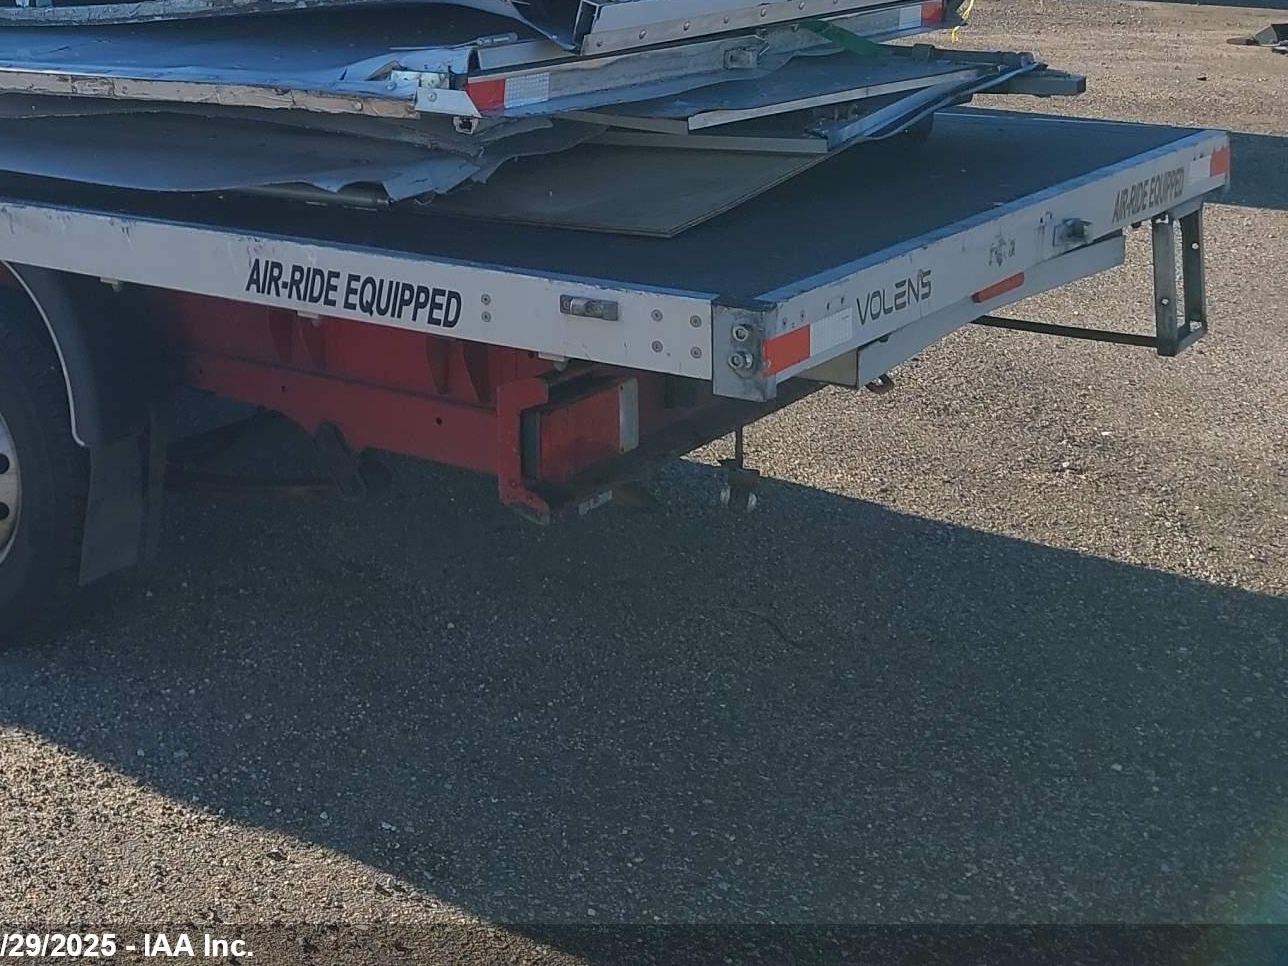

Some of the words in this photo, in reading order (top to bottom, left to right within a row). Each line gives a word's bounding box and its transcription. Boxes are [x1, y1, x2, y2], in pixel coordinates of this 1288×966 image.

[245, 258, 341, 307] AIR-RIDE
[343, 273, 462, 328] EQUIPPED
[856, 268, 932, 326] VOLENS
